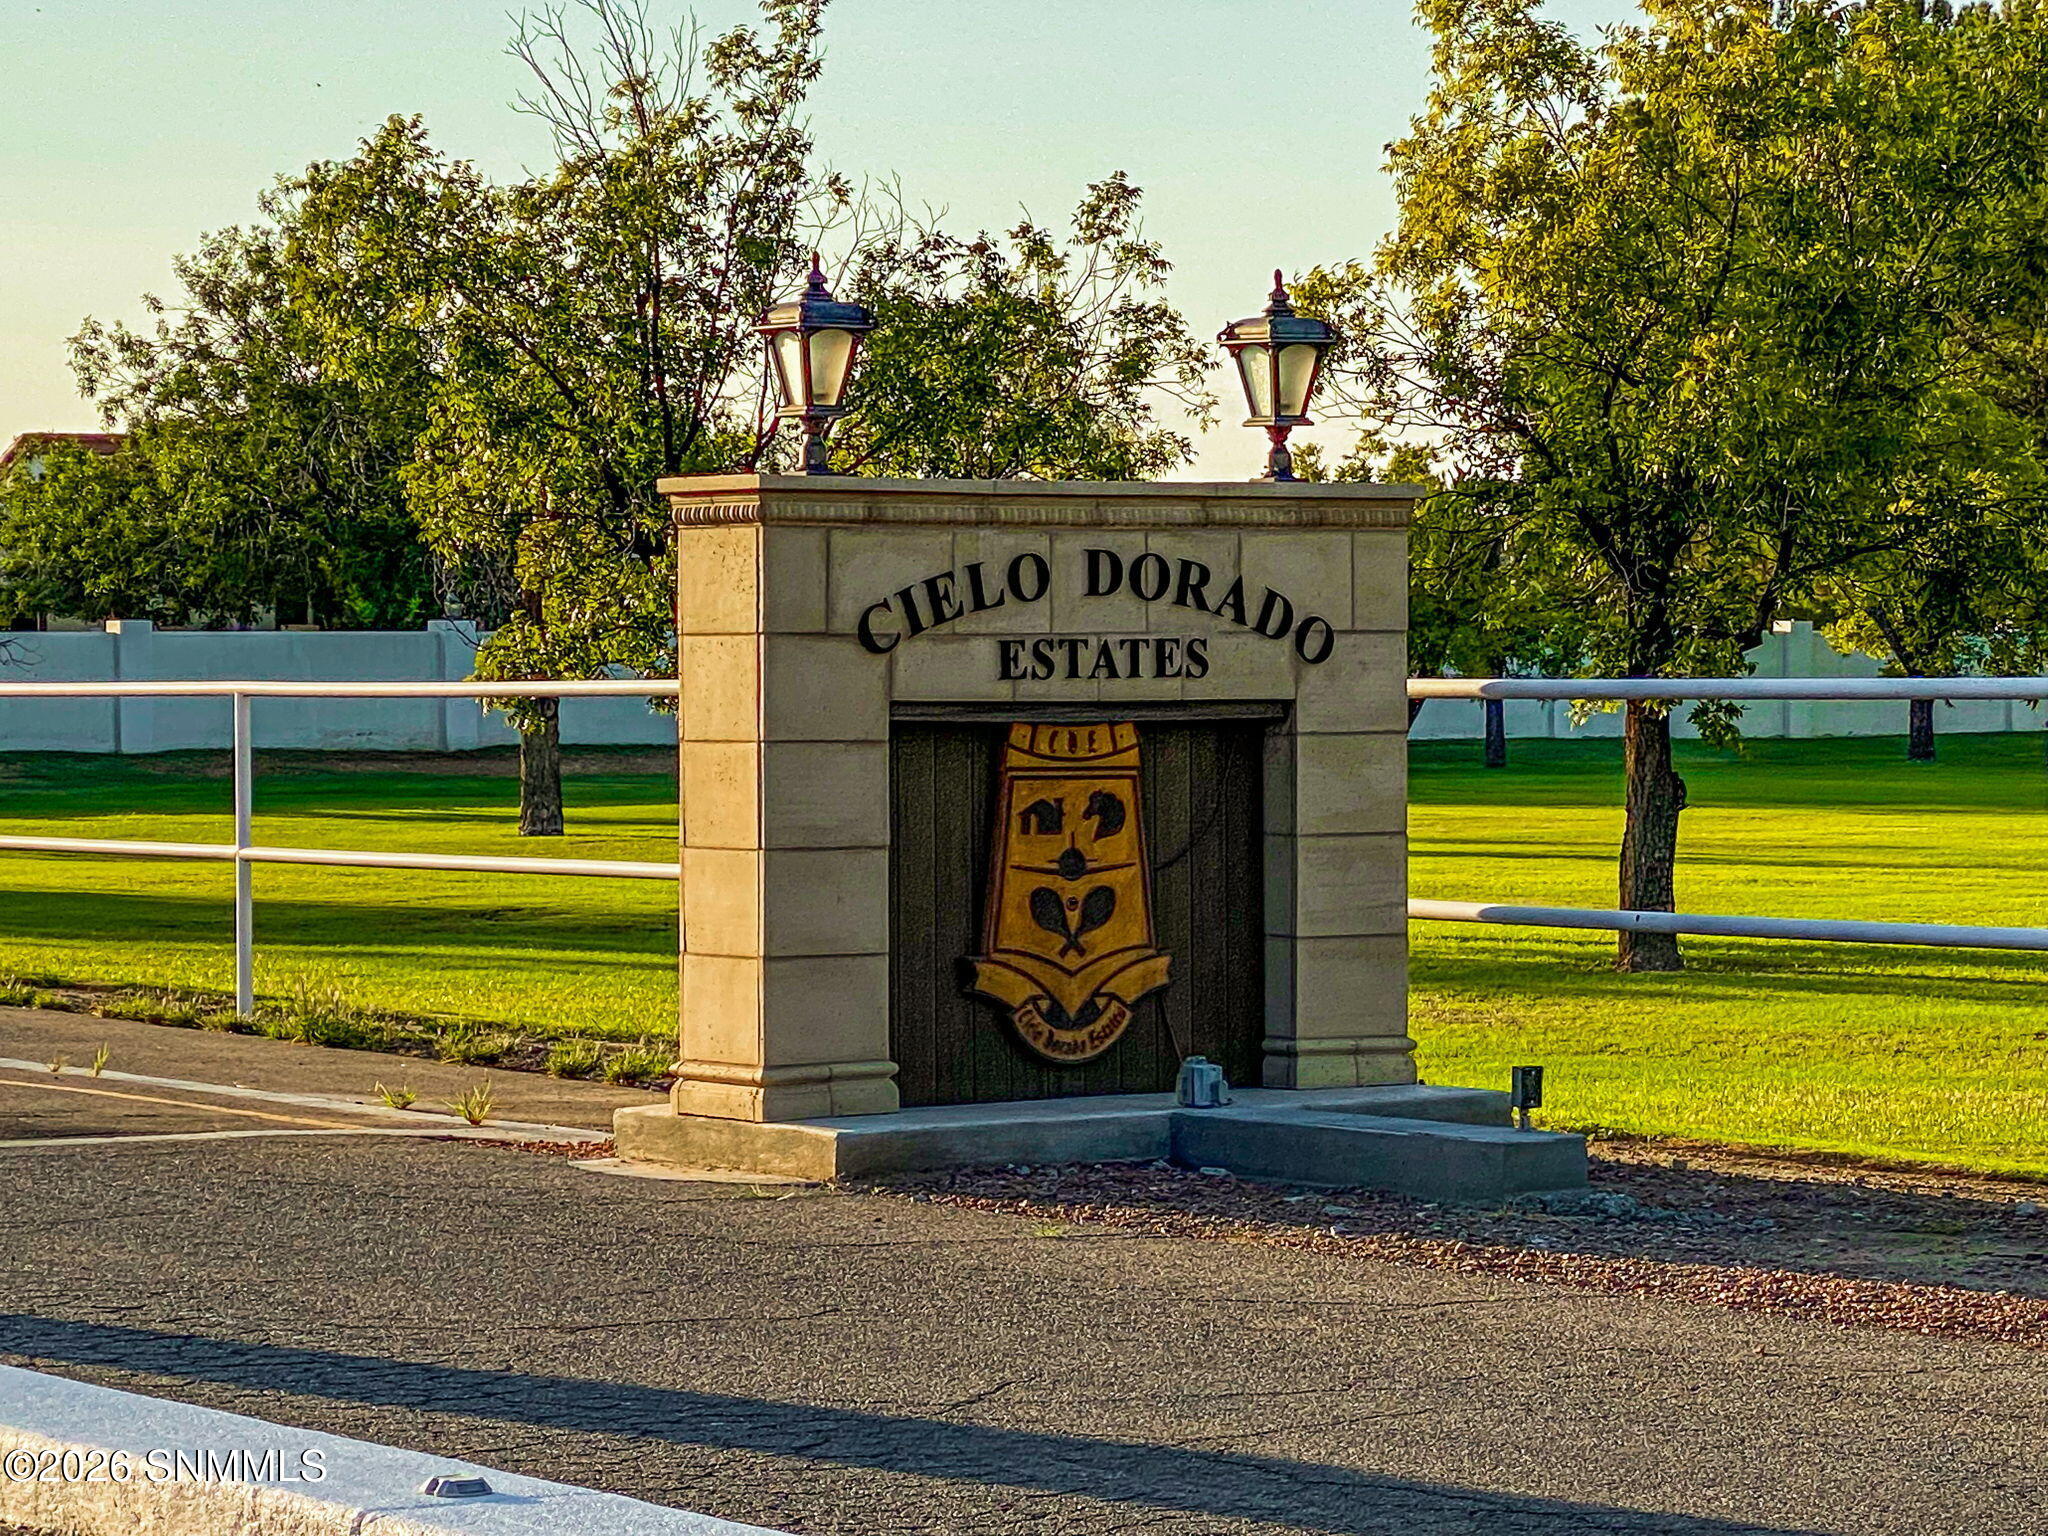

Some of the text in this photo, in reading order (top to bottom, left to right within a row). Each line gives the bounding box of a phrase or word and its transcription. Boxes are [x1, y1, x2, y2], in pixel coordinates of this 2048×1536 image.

[857, 548, 1335, 665] CIELO DORADO
[997, 637, 1211, 681] ESTATES
